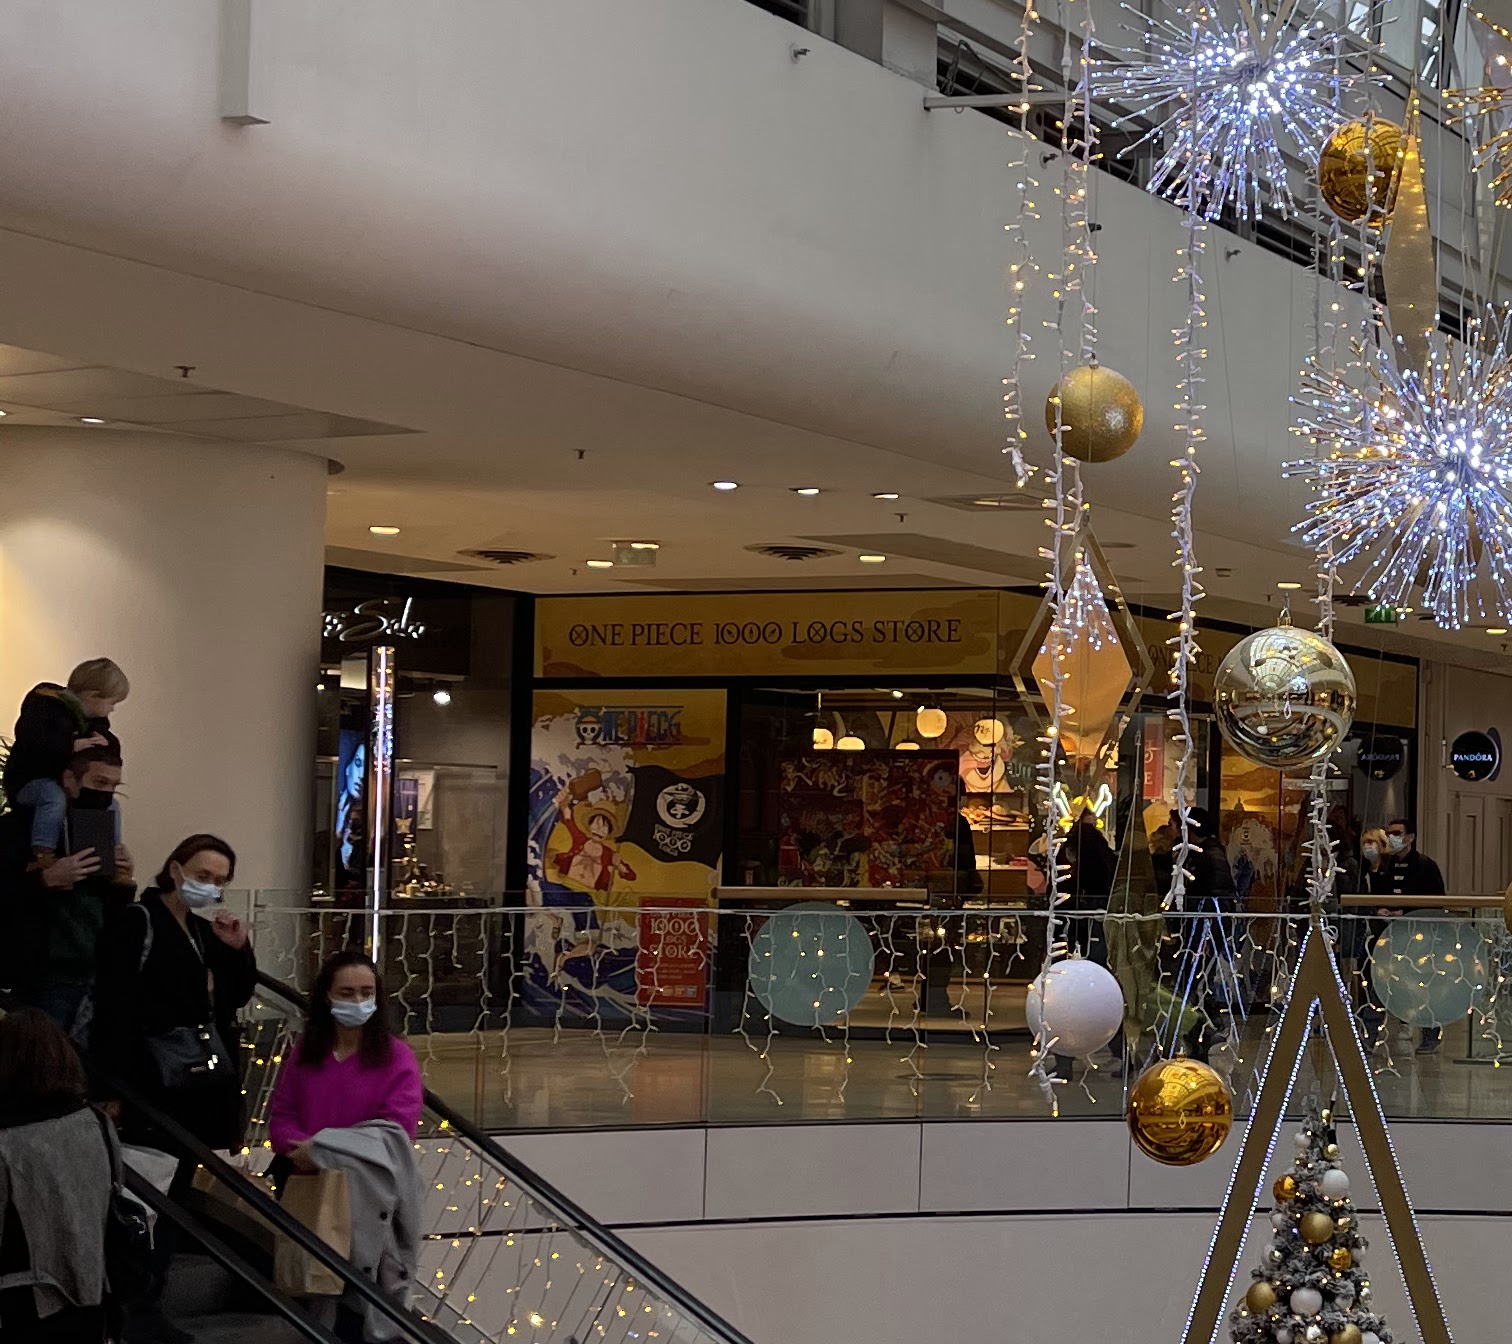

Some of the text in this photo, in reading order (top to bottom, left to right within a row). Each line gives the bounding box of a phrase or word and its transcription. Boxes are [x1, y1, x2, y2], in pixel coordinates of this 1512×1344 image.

[569, 619, 962, 647] ONE PIECE 1000 LOGS STORE
